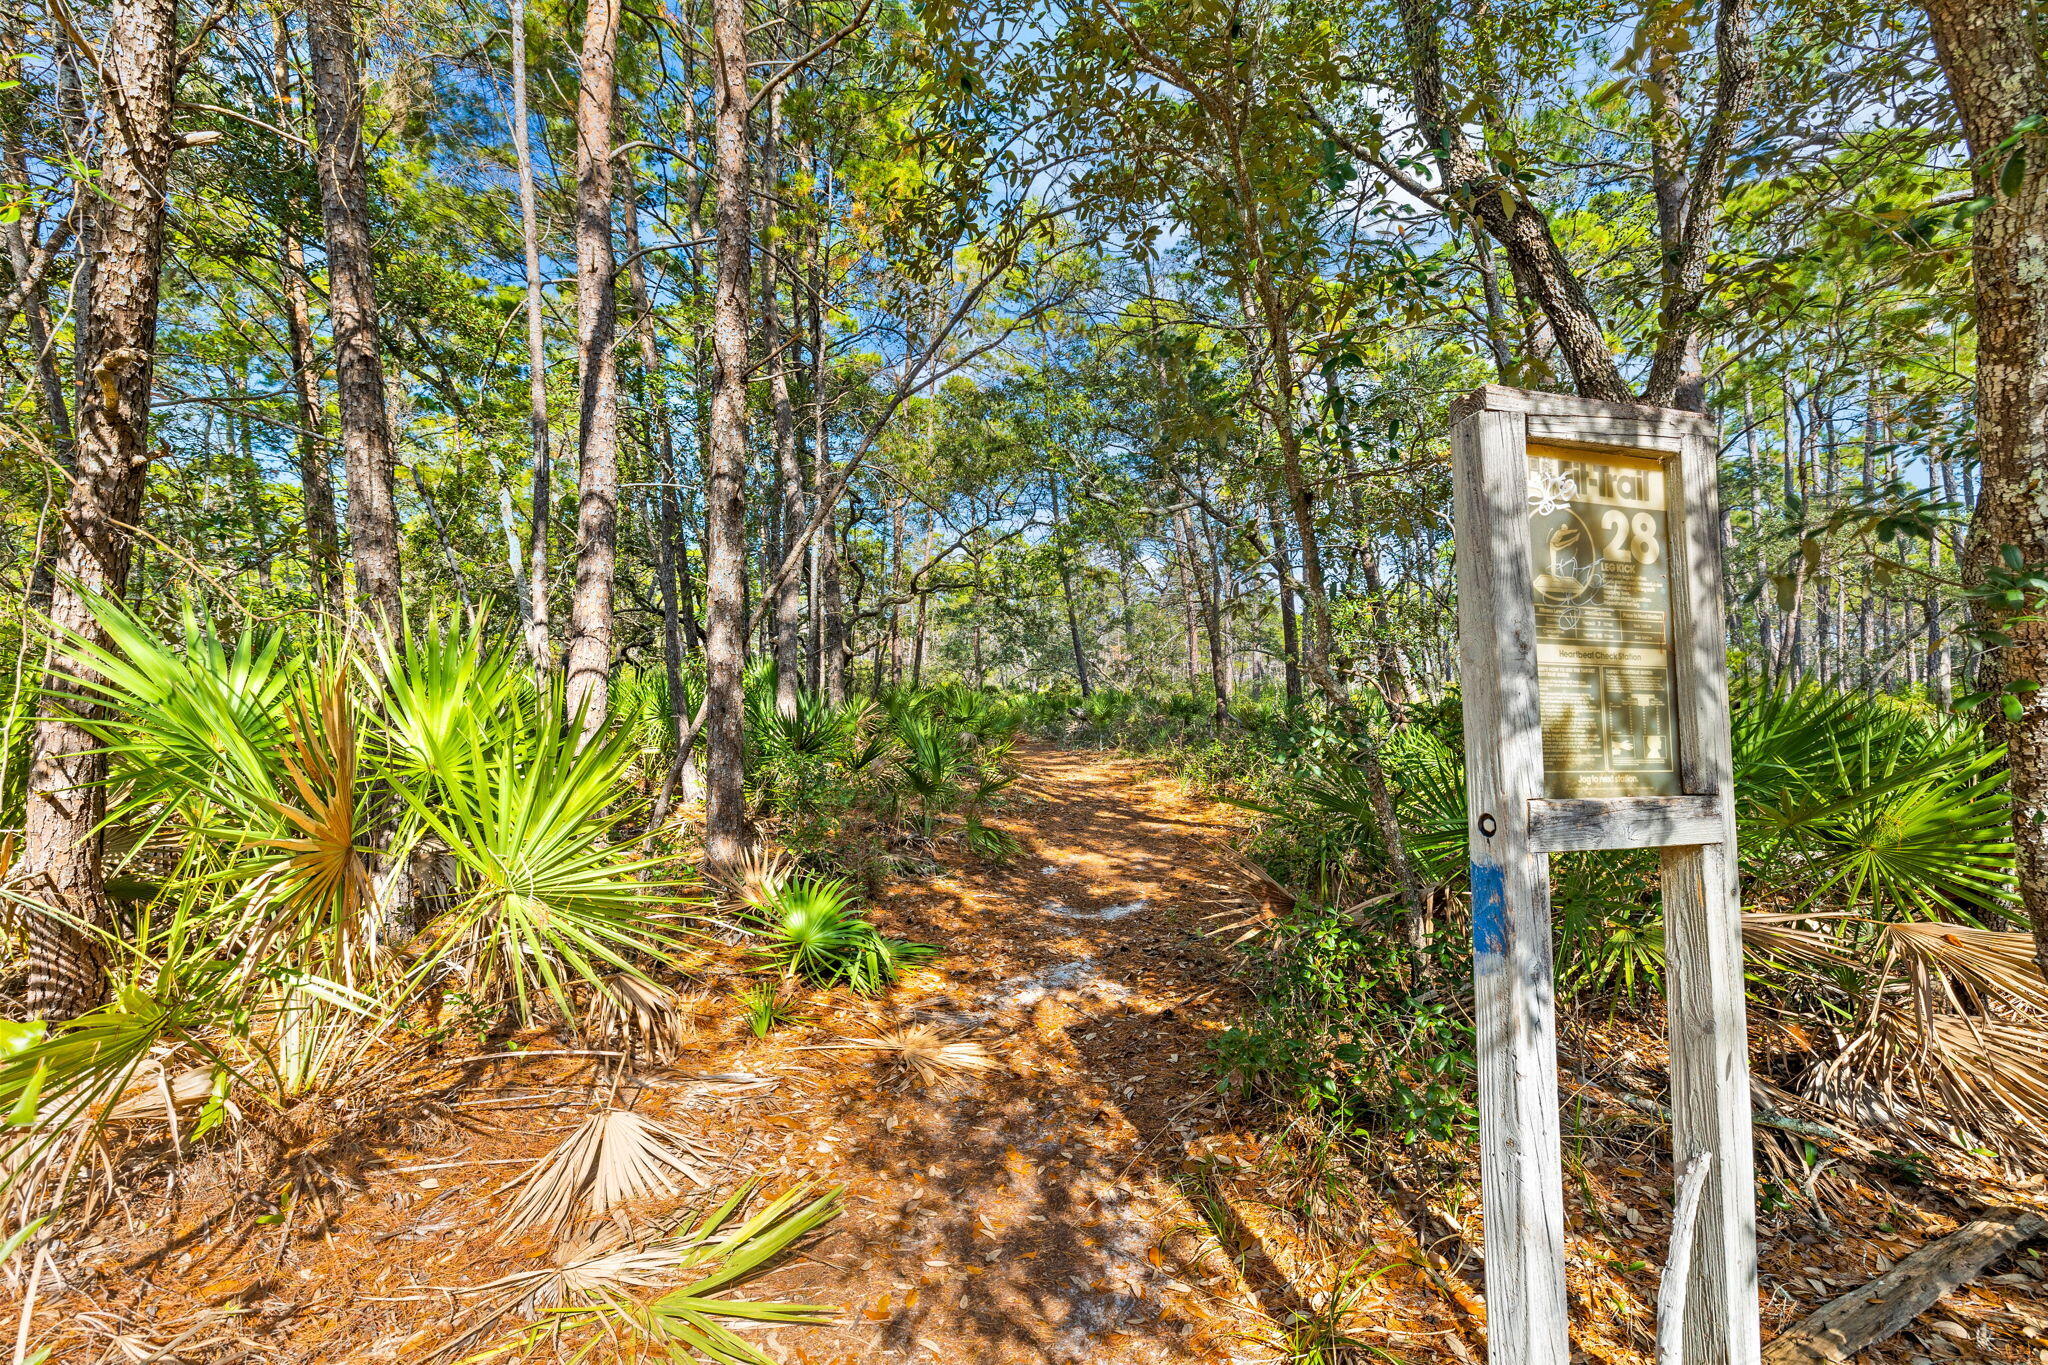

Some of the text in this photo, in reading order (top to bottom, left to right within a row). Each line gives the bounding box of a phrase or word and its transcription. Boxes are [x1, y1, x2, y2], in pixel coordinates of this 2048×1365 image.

[1601, 509, 1660, 565] 28
[1600, 562, 1636, 574] LEG KICK
[1559, 650, 1642, 661] Heartbeat Check Station
[1578, 775, 1592, 785] Jog
